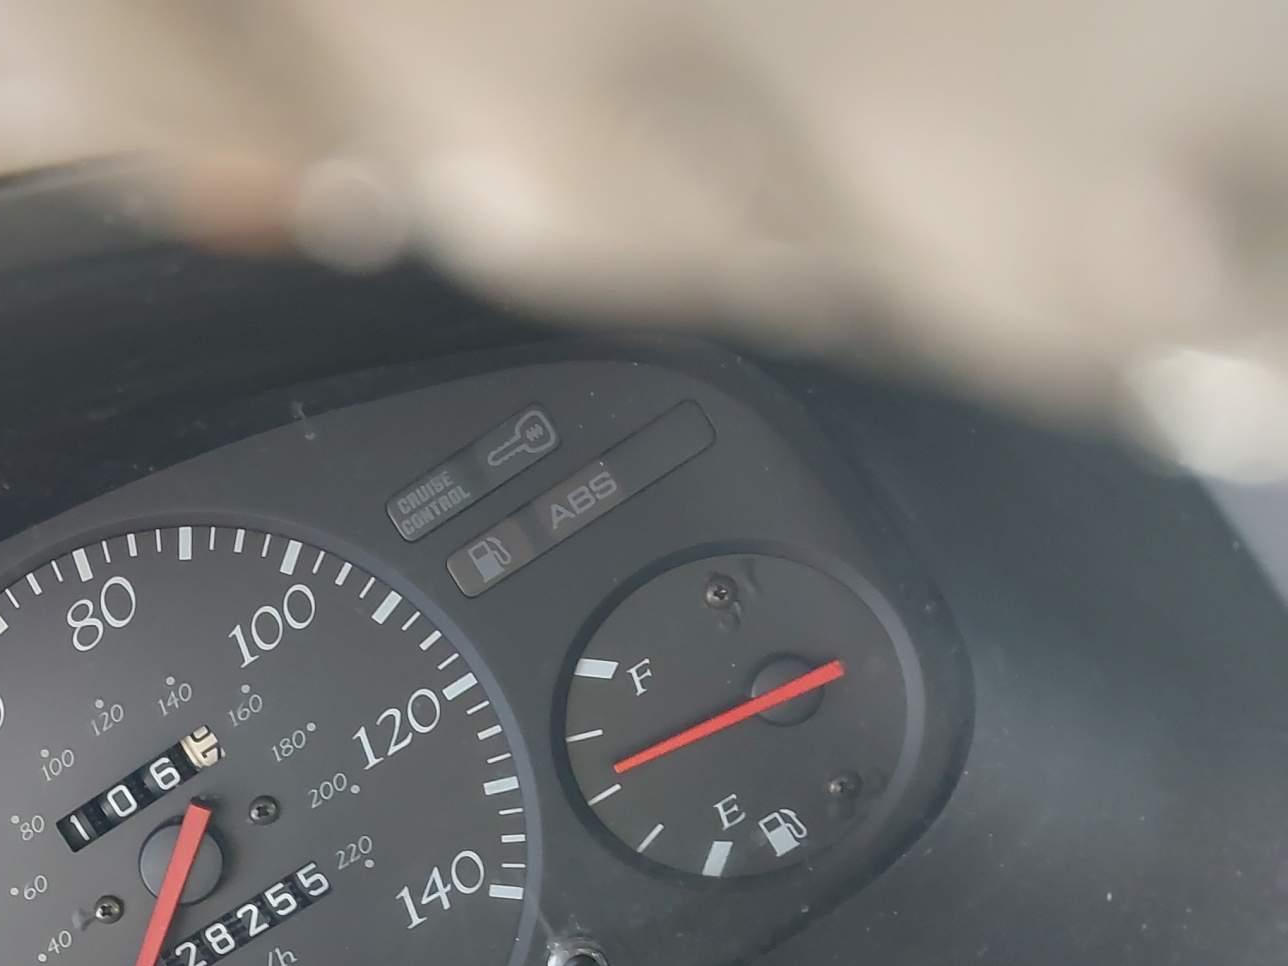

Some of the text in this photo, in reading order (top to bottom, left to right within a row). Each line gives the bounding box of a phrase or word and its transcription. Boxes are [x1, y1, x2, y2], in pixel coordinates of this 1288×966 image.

[398, 470, 453, 514] CRUISE
[549, 471, 617, 530] ABS
[401, 486, 471, 536] CONTROL
[66, 576, 136, 651] 80
[228, 583, 316, 668] 100
[626, 658, 652, 696] F
[158, 683, 192, 717] 140
[227, 694, 262, 727] 160
[91, 704, 124, 736] 120
[352, 688, 441, 770] 120
[272, 730, 306, 762] 180
[41, 749, 74, 781] 100
[308, 773, 347, 808] 200
[20, 815, 44, 840] 80
[714, 793, 746, 831] E
[336, 836, 372, 870] 220
[23, 875, 48, 900] 60
[396, 850, 485, 930] 140
[48, 930, 72, 954] 40
